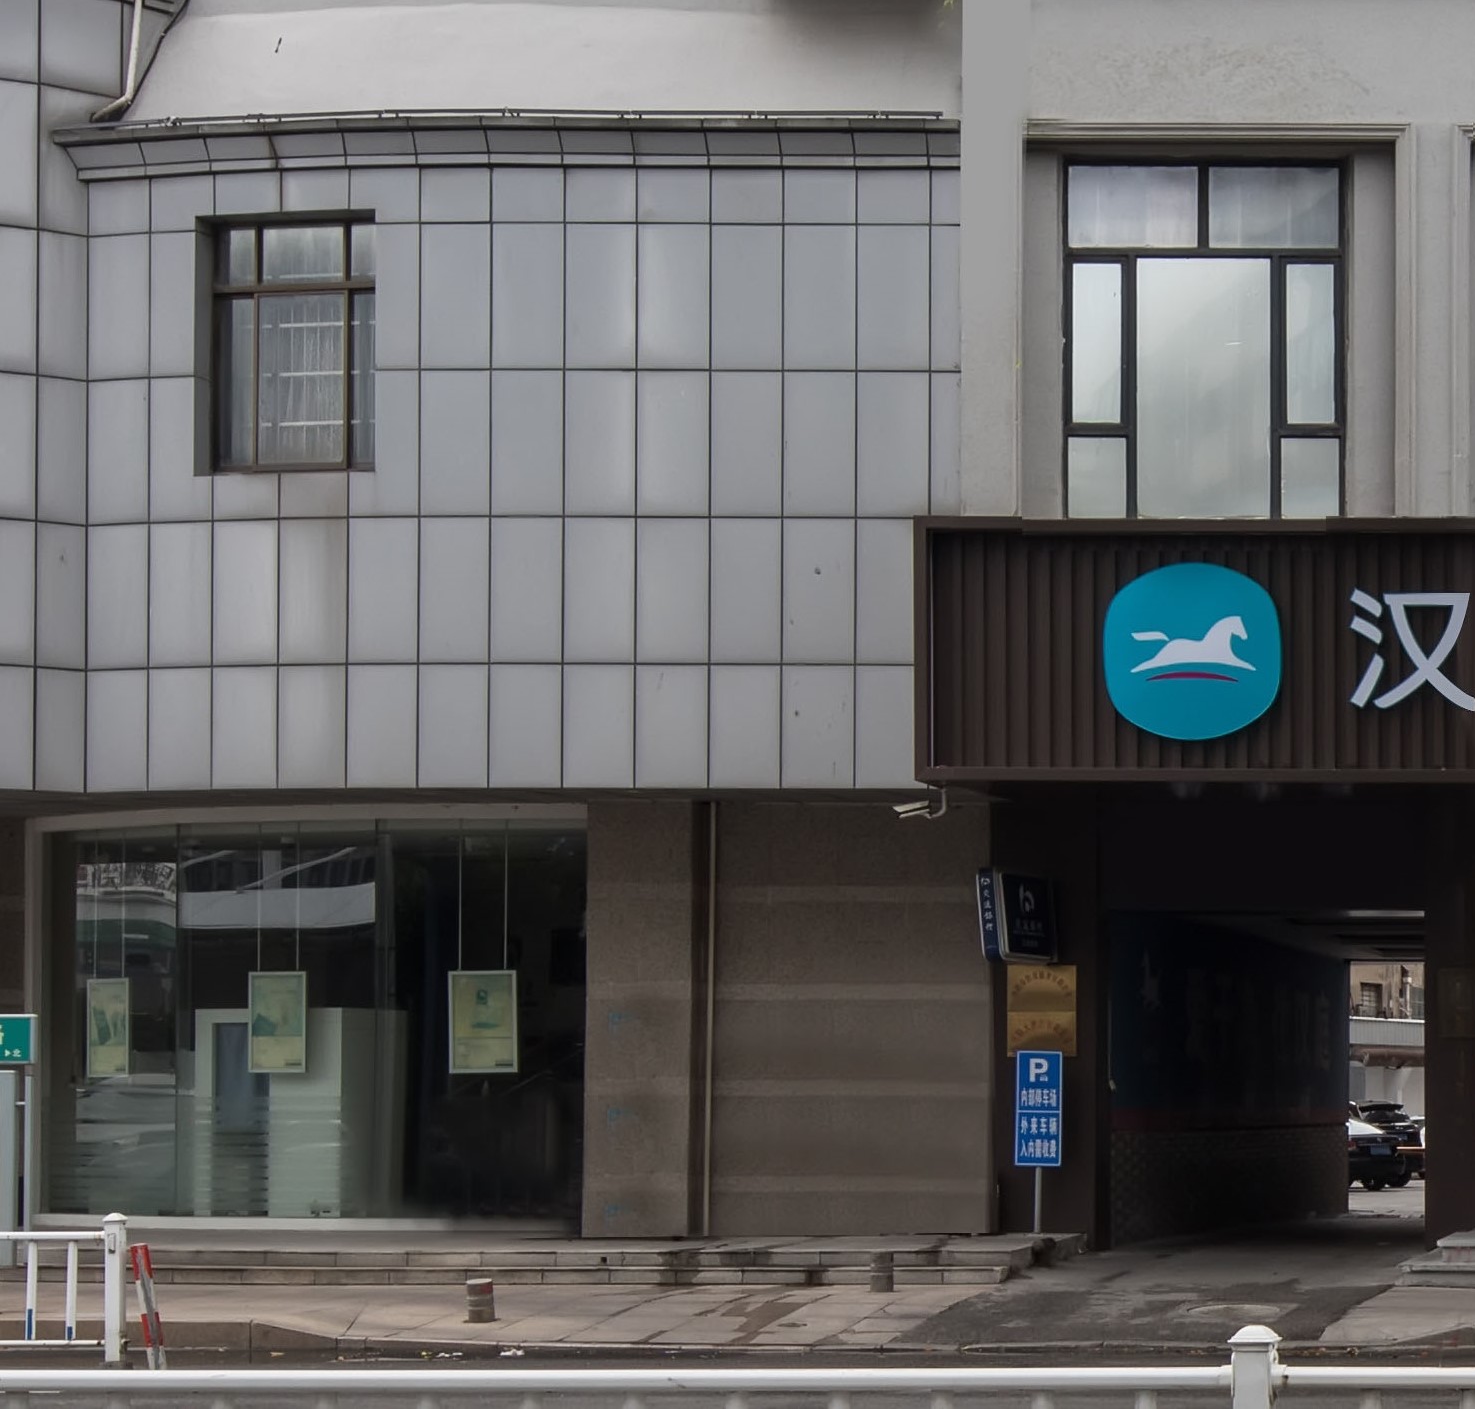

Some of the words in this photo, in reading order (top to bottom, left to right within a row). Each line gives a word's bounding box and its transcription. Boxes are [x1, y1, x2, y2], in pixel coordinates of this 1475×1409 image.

[1029, 1058, 1048, 1082] P
[1020, 1088, 1057, 1107] 内部停车场
[1020, 1116, 1057, 1135] 外来车辆
